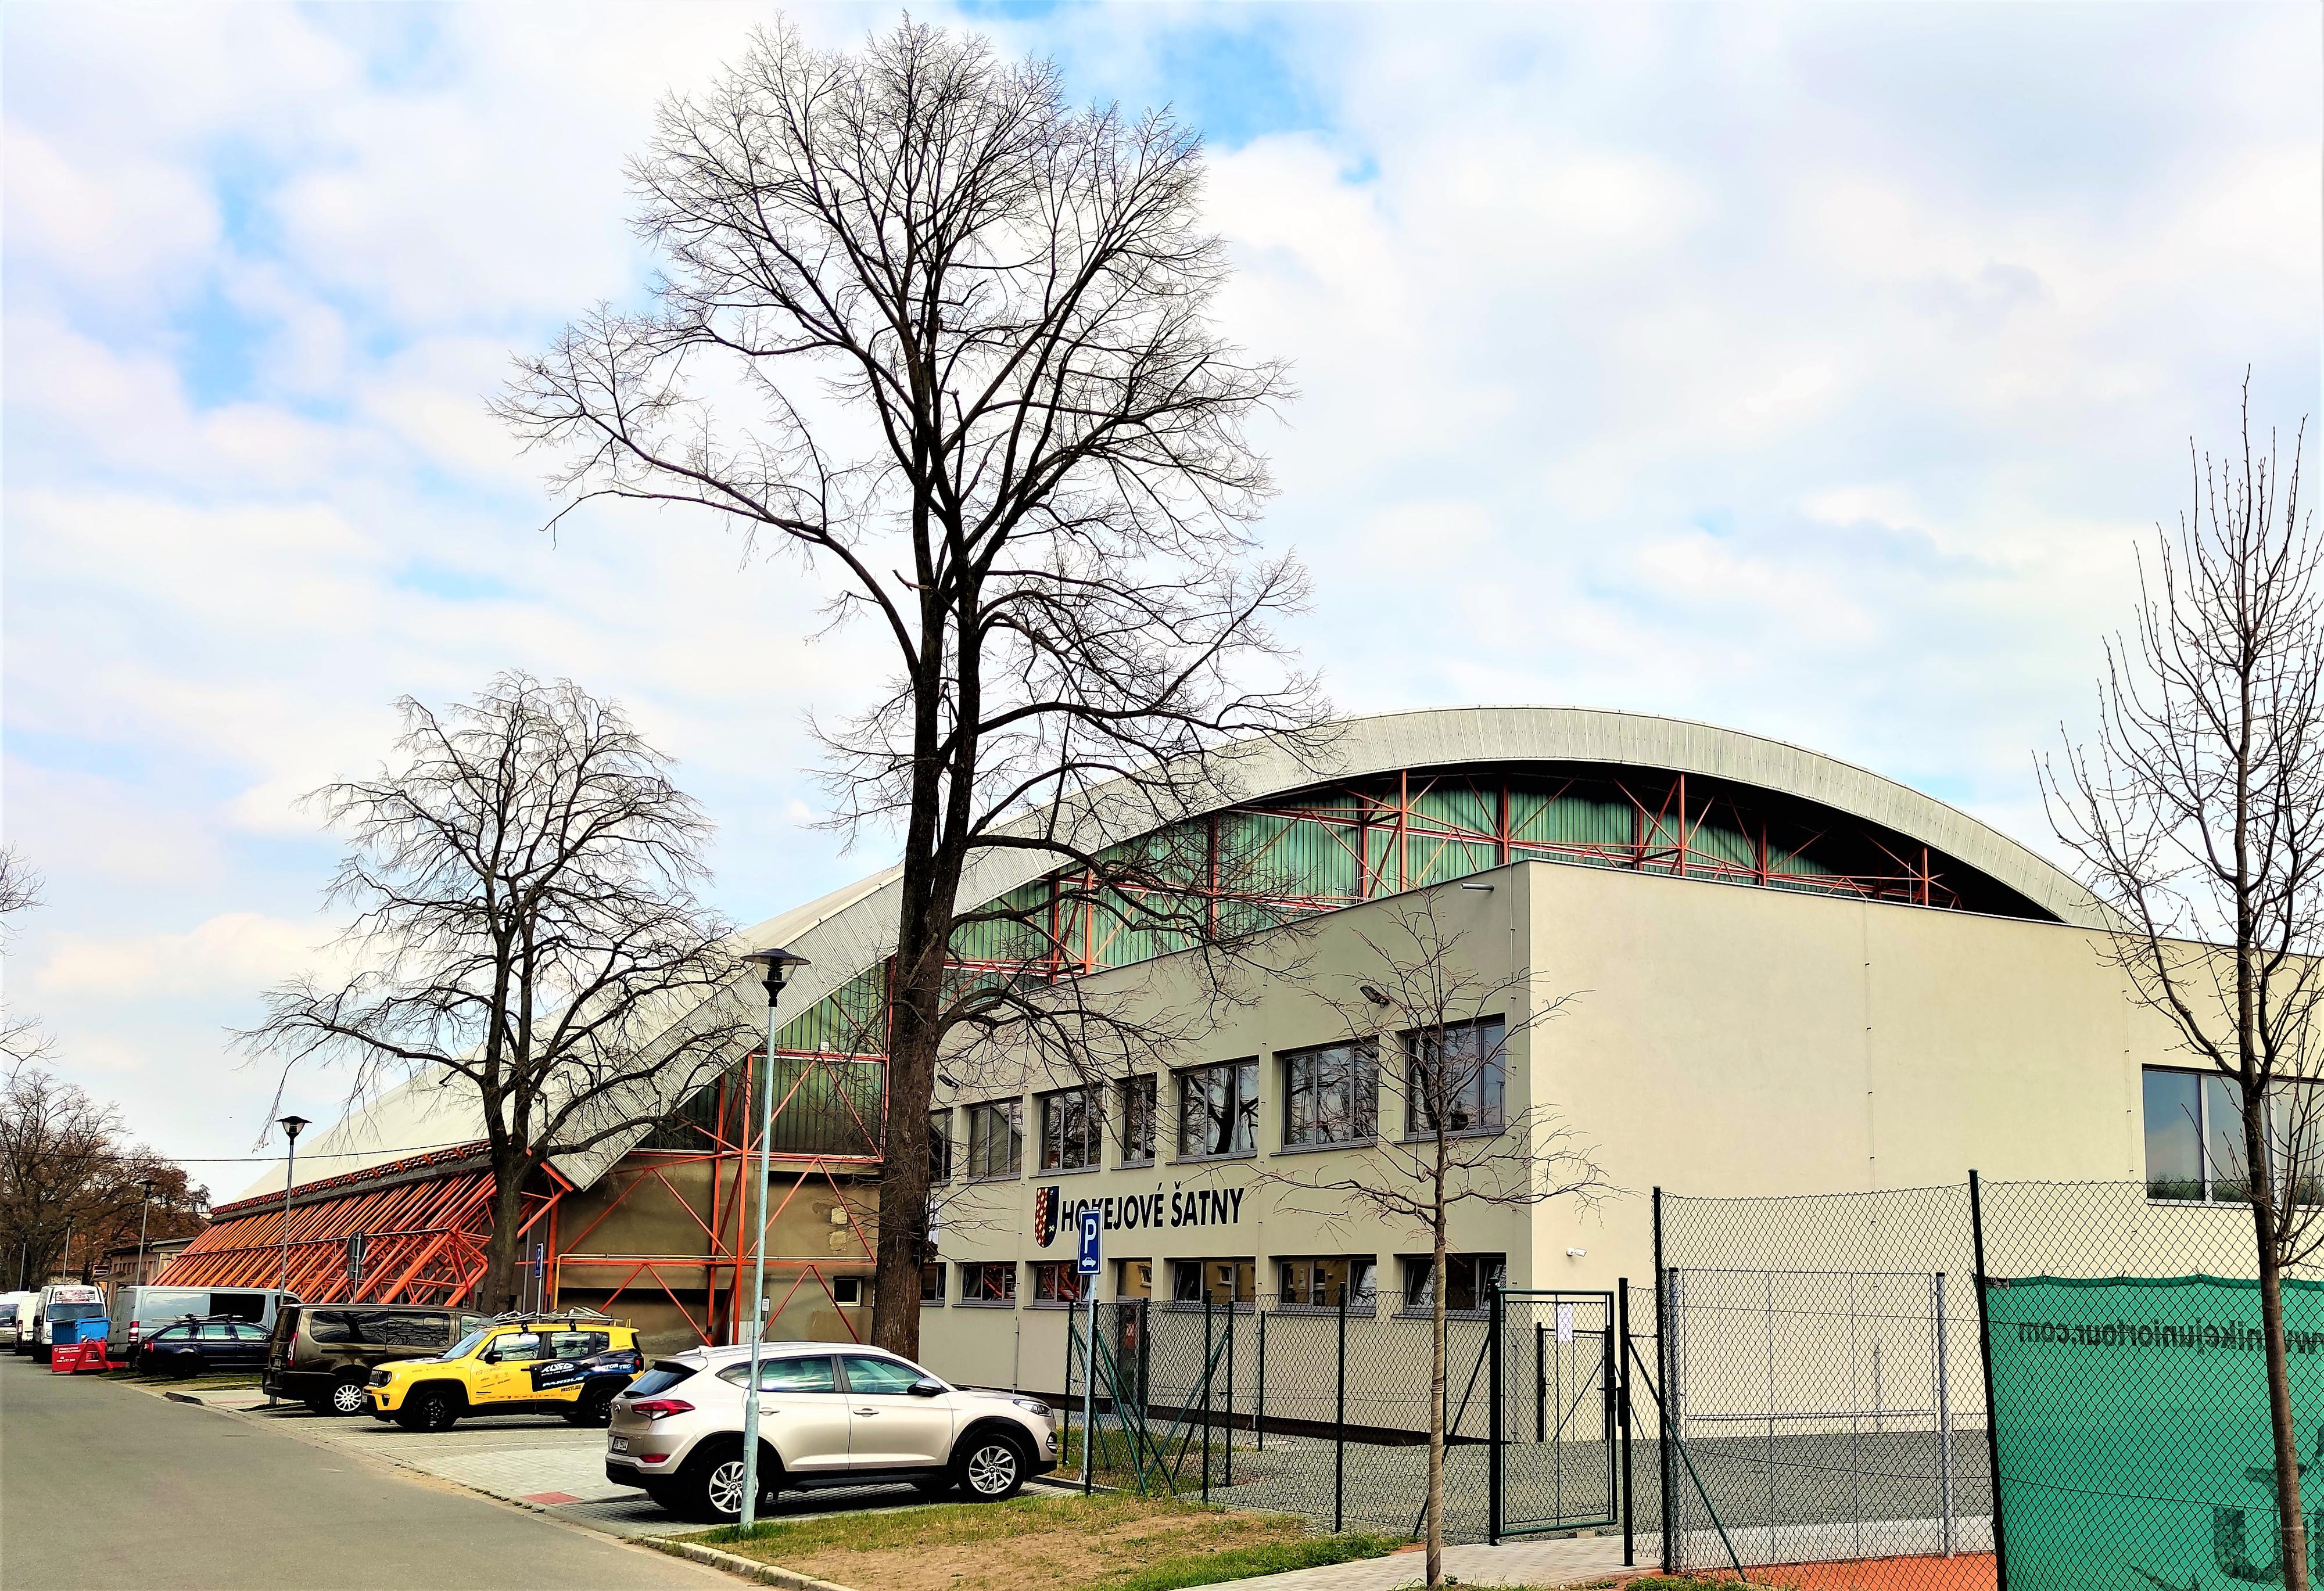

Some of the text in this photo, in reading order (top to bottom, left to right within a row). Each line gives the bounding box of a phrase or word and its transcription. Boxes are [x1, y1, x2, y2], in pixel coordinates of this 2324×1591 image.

[1171, 1180, 1245, 1228] ŠATNY
[1084, 1219, 1097, 1254] P
[537, 1248, 541, 1267] P
